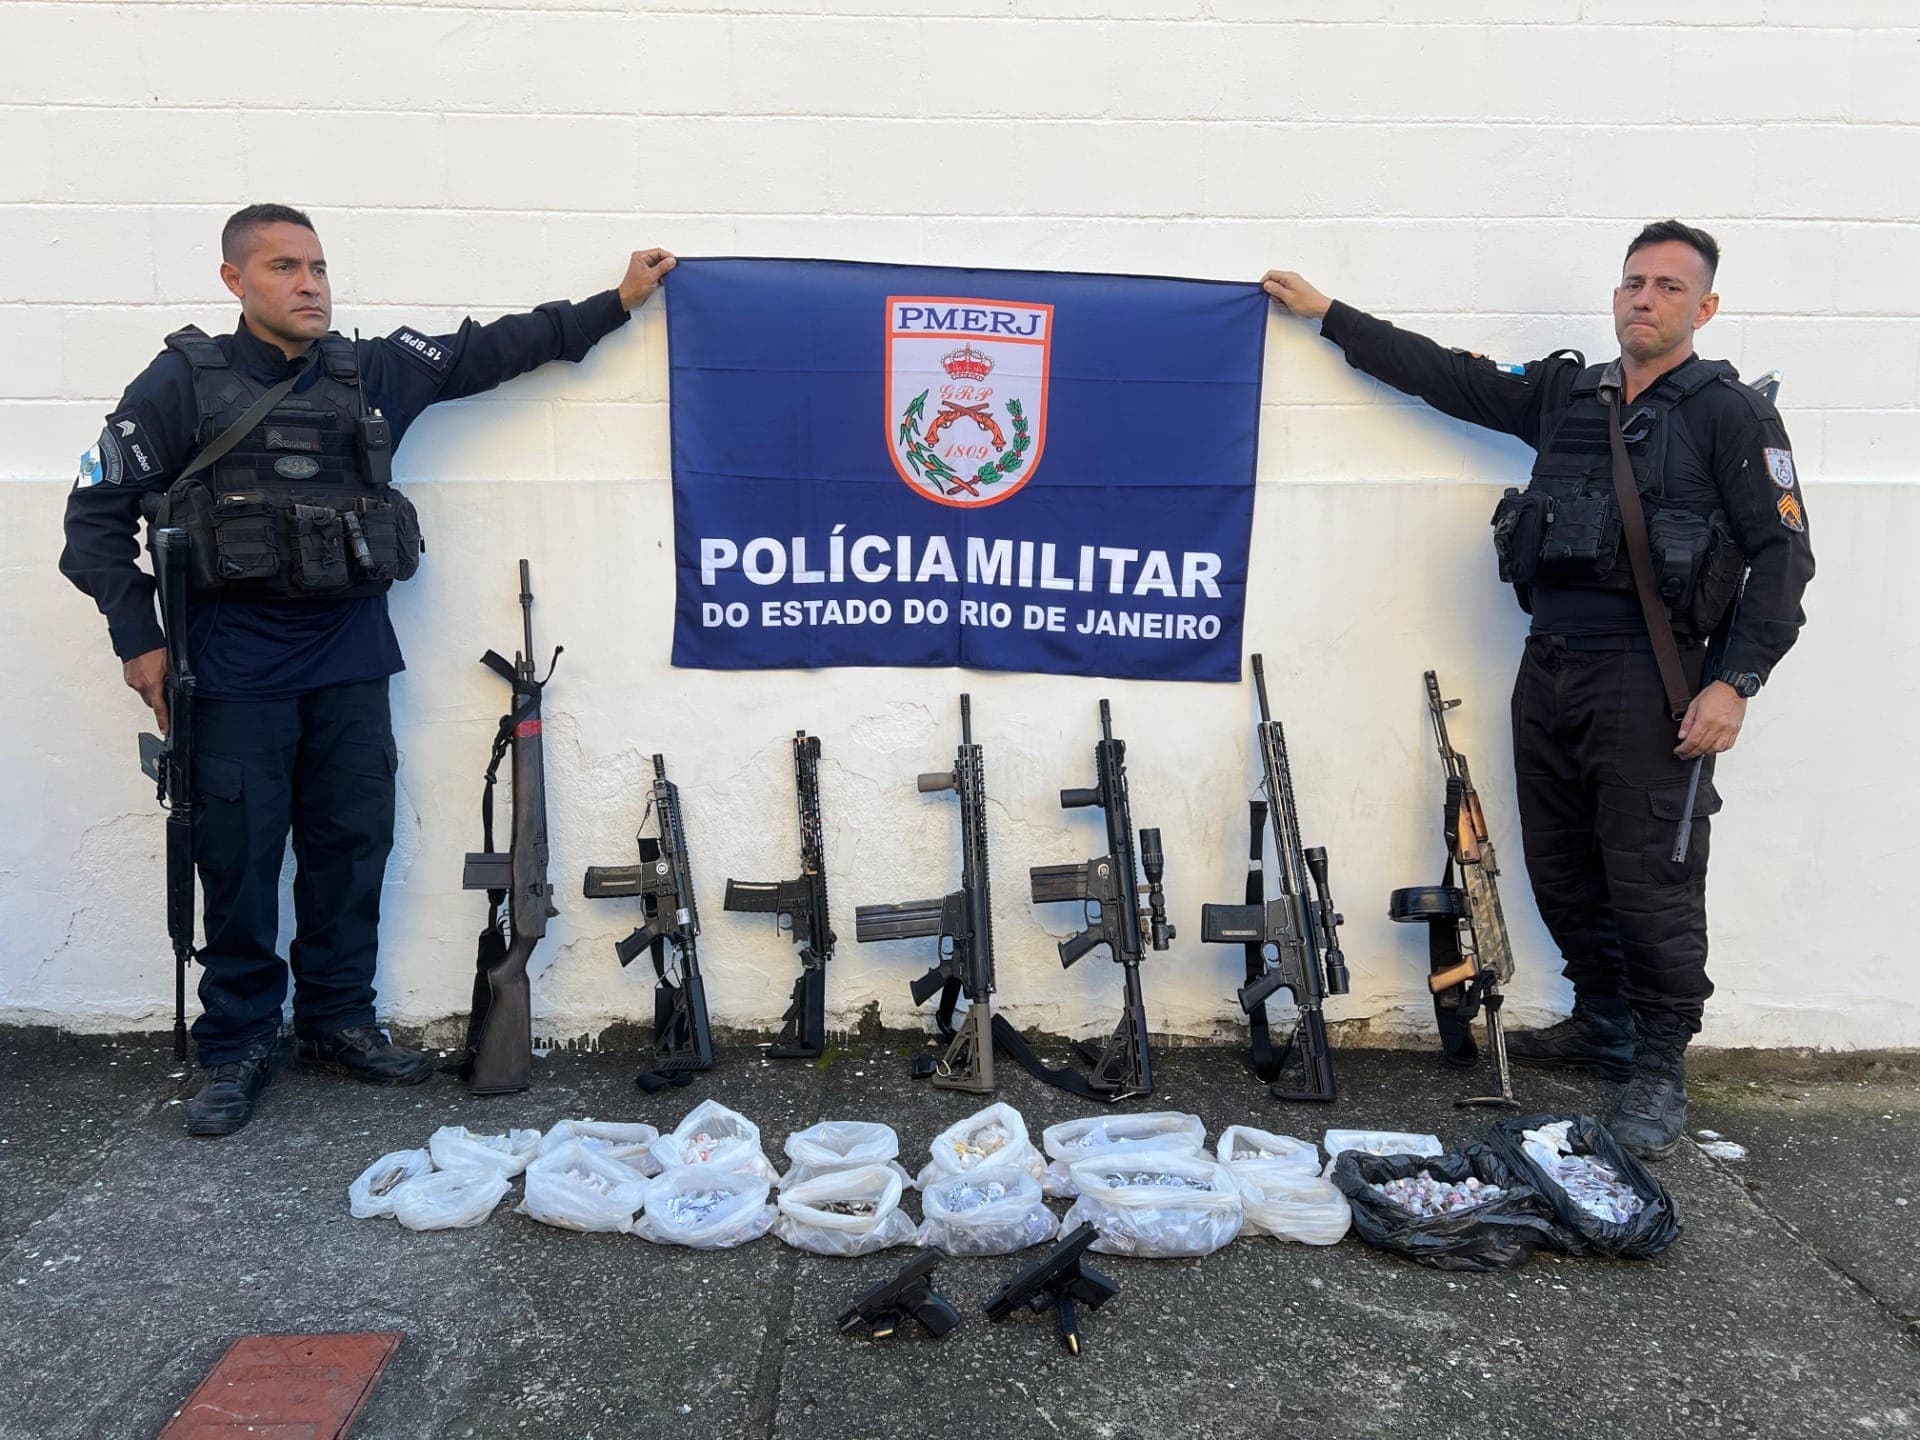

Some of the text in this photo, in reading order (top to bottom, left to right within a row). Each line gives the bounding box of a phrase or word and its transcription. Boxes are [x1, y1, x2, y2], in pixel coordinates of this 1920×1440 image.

[898, 307, 1041, 335] PMERJ
[400, 332, 427, 351] BPM
[943, 444, 989, 459] 1809
[700, 523, 1222, 598] POLÍCIA MILITAR
[702, 598, 1221, 640] DO ESTADO DO RIO DE JANEIRO
